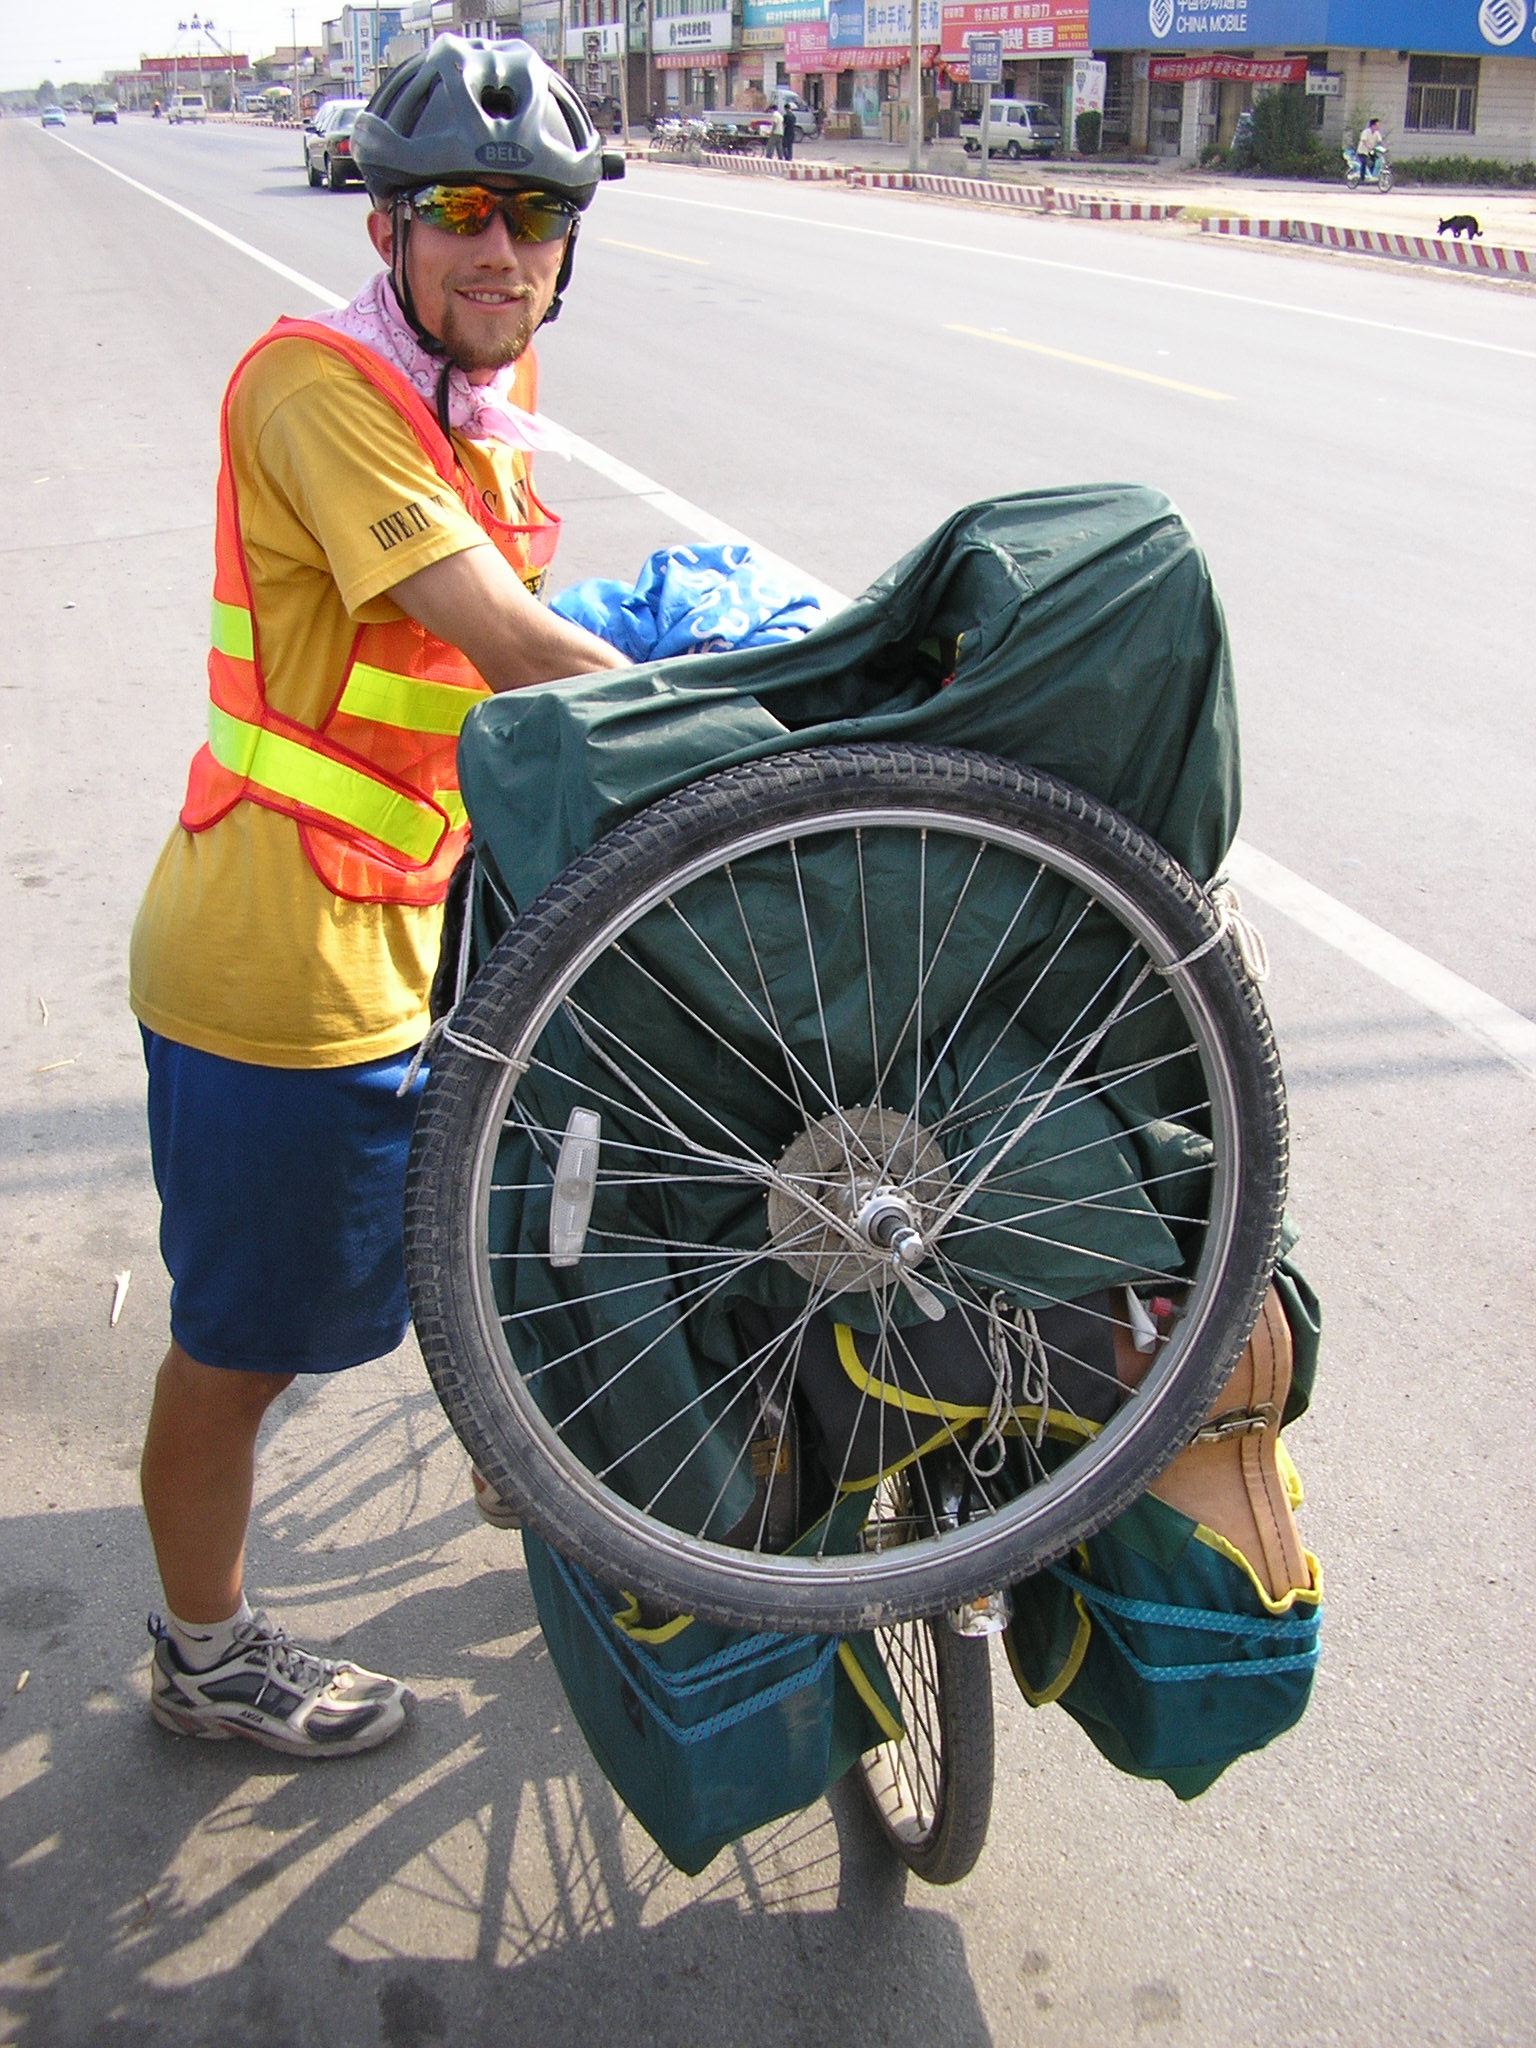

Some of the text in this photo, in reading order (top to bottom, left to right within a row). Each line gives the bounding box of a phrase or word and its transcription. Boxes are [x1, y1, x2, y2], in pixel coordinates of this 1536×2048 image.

[1176, 13, 1247, 33] CHINA MOBILE
[487, 146, 525, 162] BELL
[369, 502, 431, 551] LIVE IT
[240, 1711, 264, 1723] AVIA
